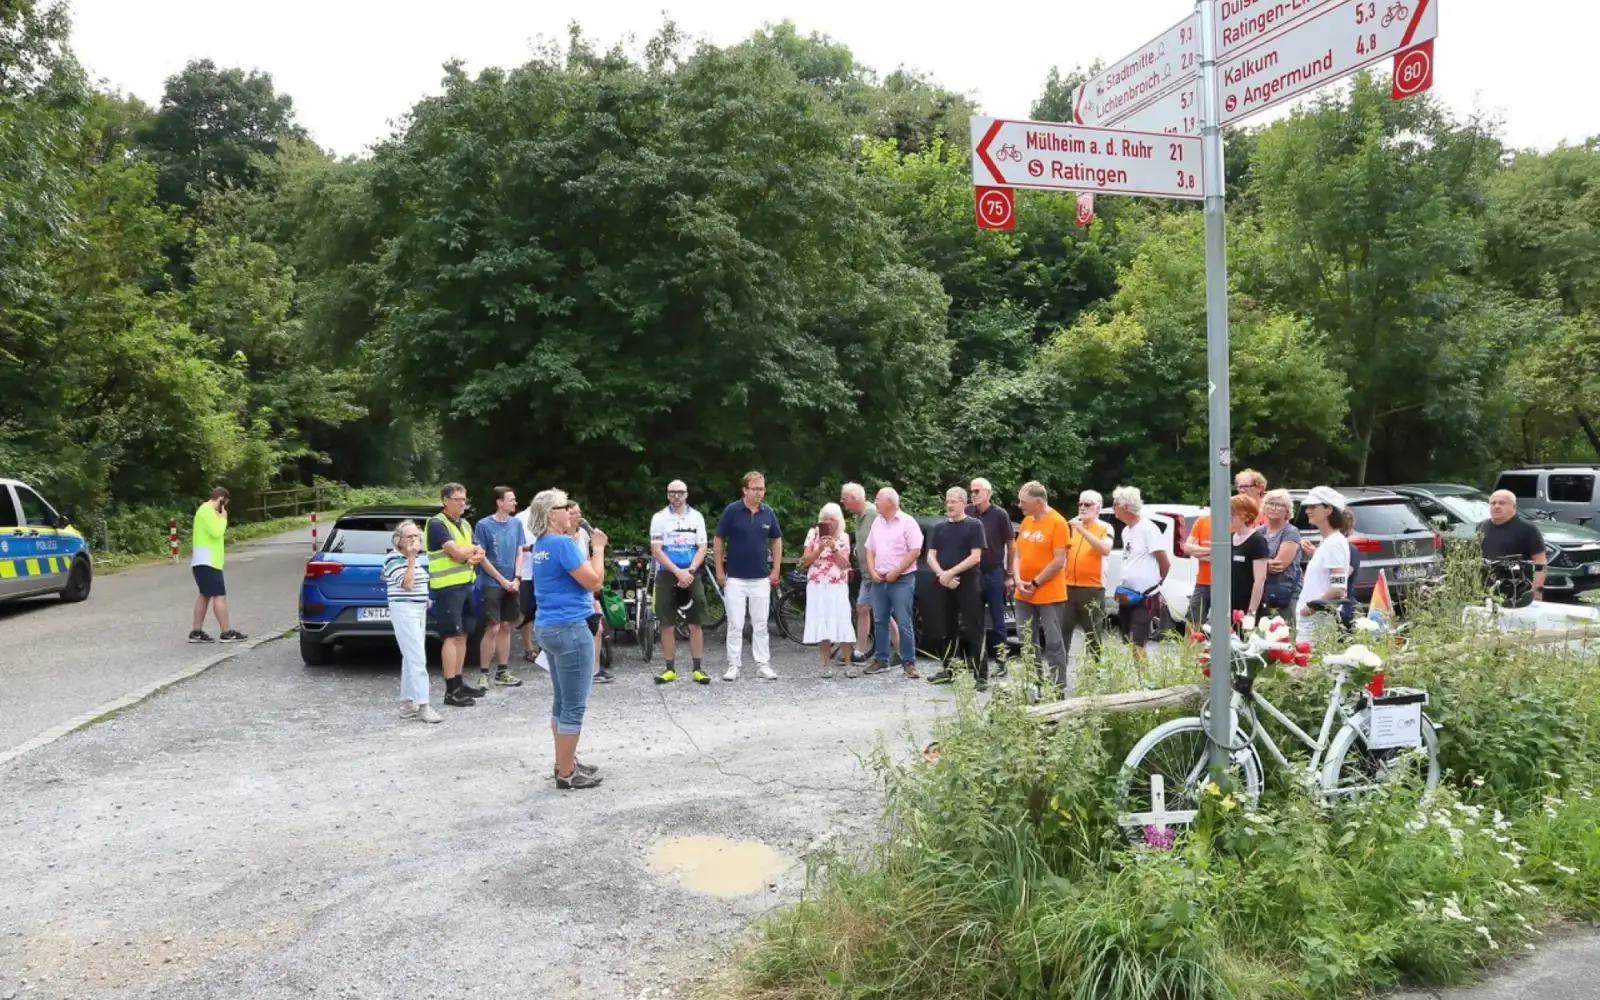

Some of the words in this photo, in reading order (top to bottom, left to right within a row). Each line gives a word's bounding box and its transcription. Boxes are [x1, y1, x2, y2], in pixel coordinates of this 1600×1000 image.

[1221, 0, 1259, 21] Duis
[1223, 0, 1310, 47] Ratingen-L
[1106, 50, 1155, 90] Stadtmitte
[1180, 27, 1192, 45] 9,3
[1224, 50, 1278, 87] Kalkum
[1355, 2, 1376, 25] 5,3
[1244, 49, 1333, 106] Angermund
[1356, 33, 1377, 55] 4,8
[1403, 64, 1421, 82] 80
[1096, 71, 1161, 118] Lichtenbroich
[1026, 130, 1086, 154] Mülheim
[1090, 141, 1102, 155] a.
[1106, 138, 1118, 156] d.
[1122, 138, 1153, 159] Ruhr
[1169, 143, 1184, 161] 21
[1051, 160, 1128, 186] Ratingen
[1177, 170, 1195, 189] 3,8
[987, 201, 1003, 216] 75
